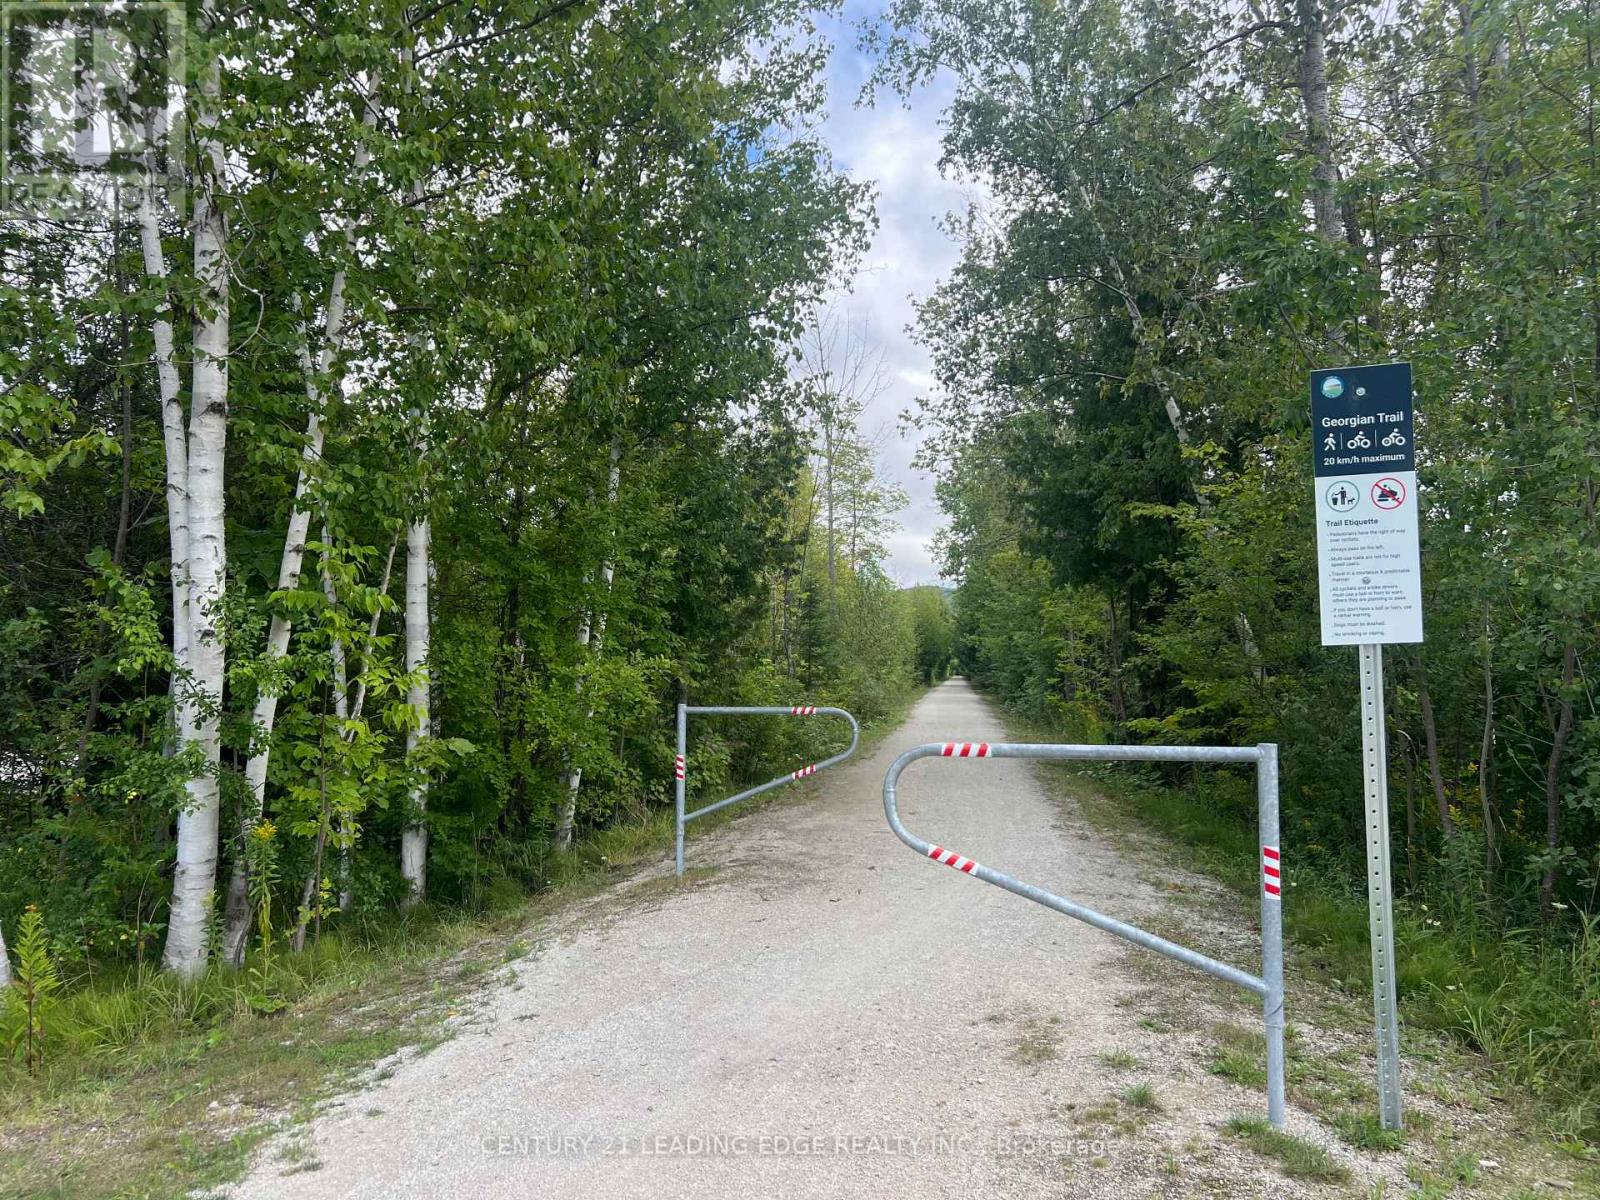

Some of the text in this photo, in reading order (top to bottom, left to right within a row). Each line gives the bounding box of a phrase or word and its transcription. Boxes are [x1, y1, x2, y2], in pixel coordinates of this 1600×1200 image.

[1322, 411, 1404, 428] Georgian Trail
[1324, 453, 1405, 466] 20 km/h maximum
[1344, 518, 1378, 527] Etiquette
